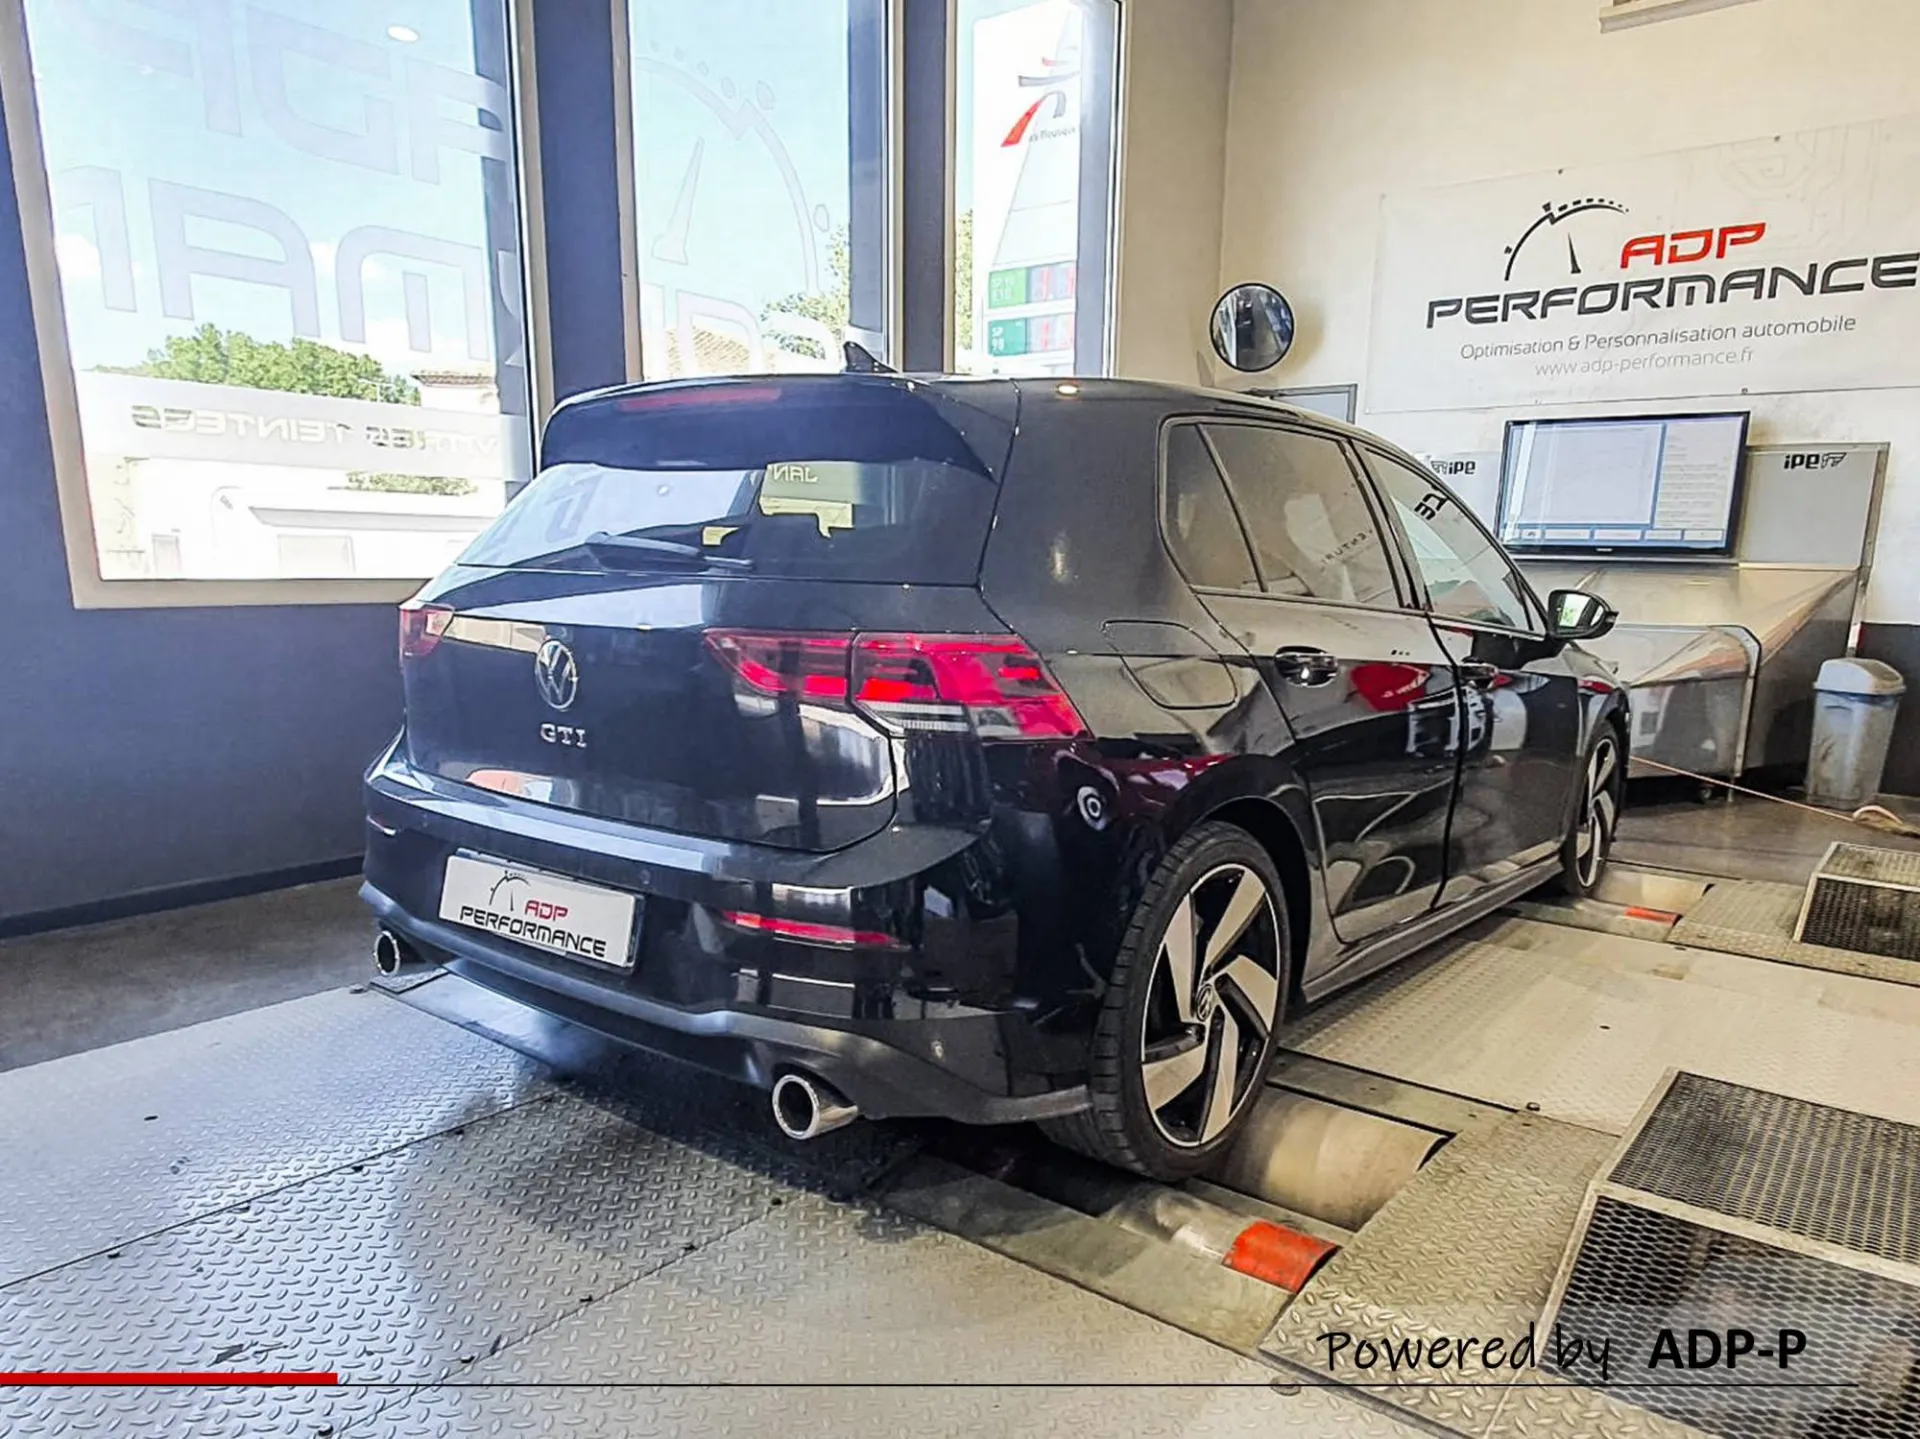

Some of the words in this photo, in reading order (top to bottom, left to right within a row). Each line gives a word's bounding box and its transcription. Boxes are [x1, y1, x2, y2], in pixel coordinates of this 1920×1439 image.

[1619, 220, 1768, 270] ADP
[1425, 251, 1920, 330] PERFORMANCE
[1460, 334, 1565, 362] Optimisation
[1567, 335, 1581, 351] &
[1583, 323, 1738, 352] Personnalisation
[1742, 313, 1857, 340] automobile
[1534, 346, 1756, 377] www.adp-performance.fr
[539, 722, 588, 749] GTI
[460, 904, 607, 958] PERFORMANCE
[523, 899, 569, 921] ADP
